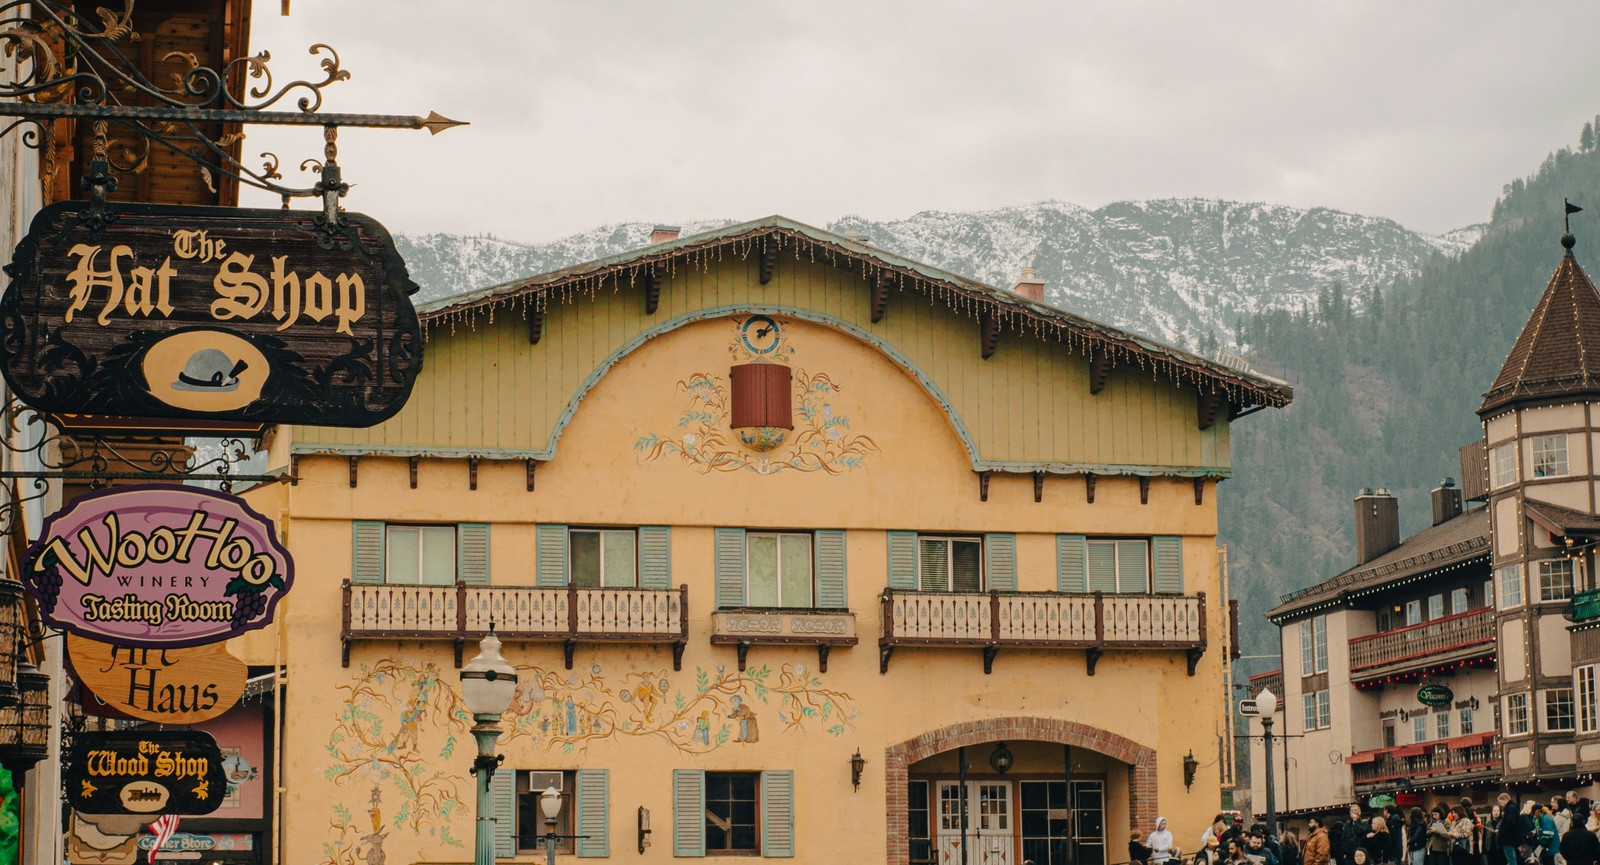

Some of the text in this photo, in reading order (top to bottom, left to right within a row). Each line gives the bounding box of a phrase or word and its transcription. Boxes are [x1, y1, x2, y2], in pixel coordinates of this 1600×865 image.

[172, 229, 228, 264] The
[65, 243, 366, 337] Hat Shop
[33, 511, 278, 587] WooHoo
[117, 576, 210, 588] WINERY
[81, 593, 235, 626] Tasting Room
[121, 667, 218, 714] Haus
[138, 740, 161, 755] The
[87, 750, 209, 781] Wood Shop
[141, 837, 179, 849] Coner
[181, 836, 212, 850] Store
